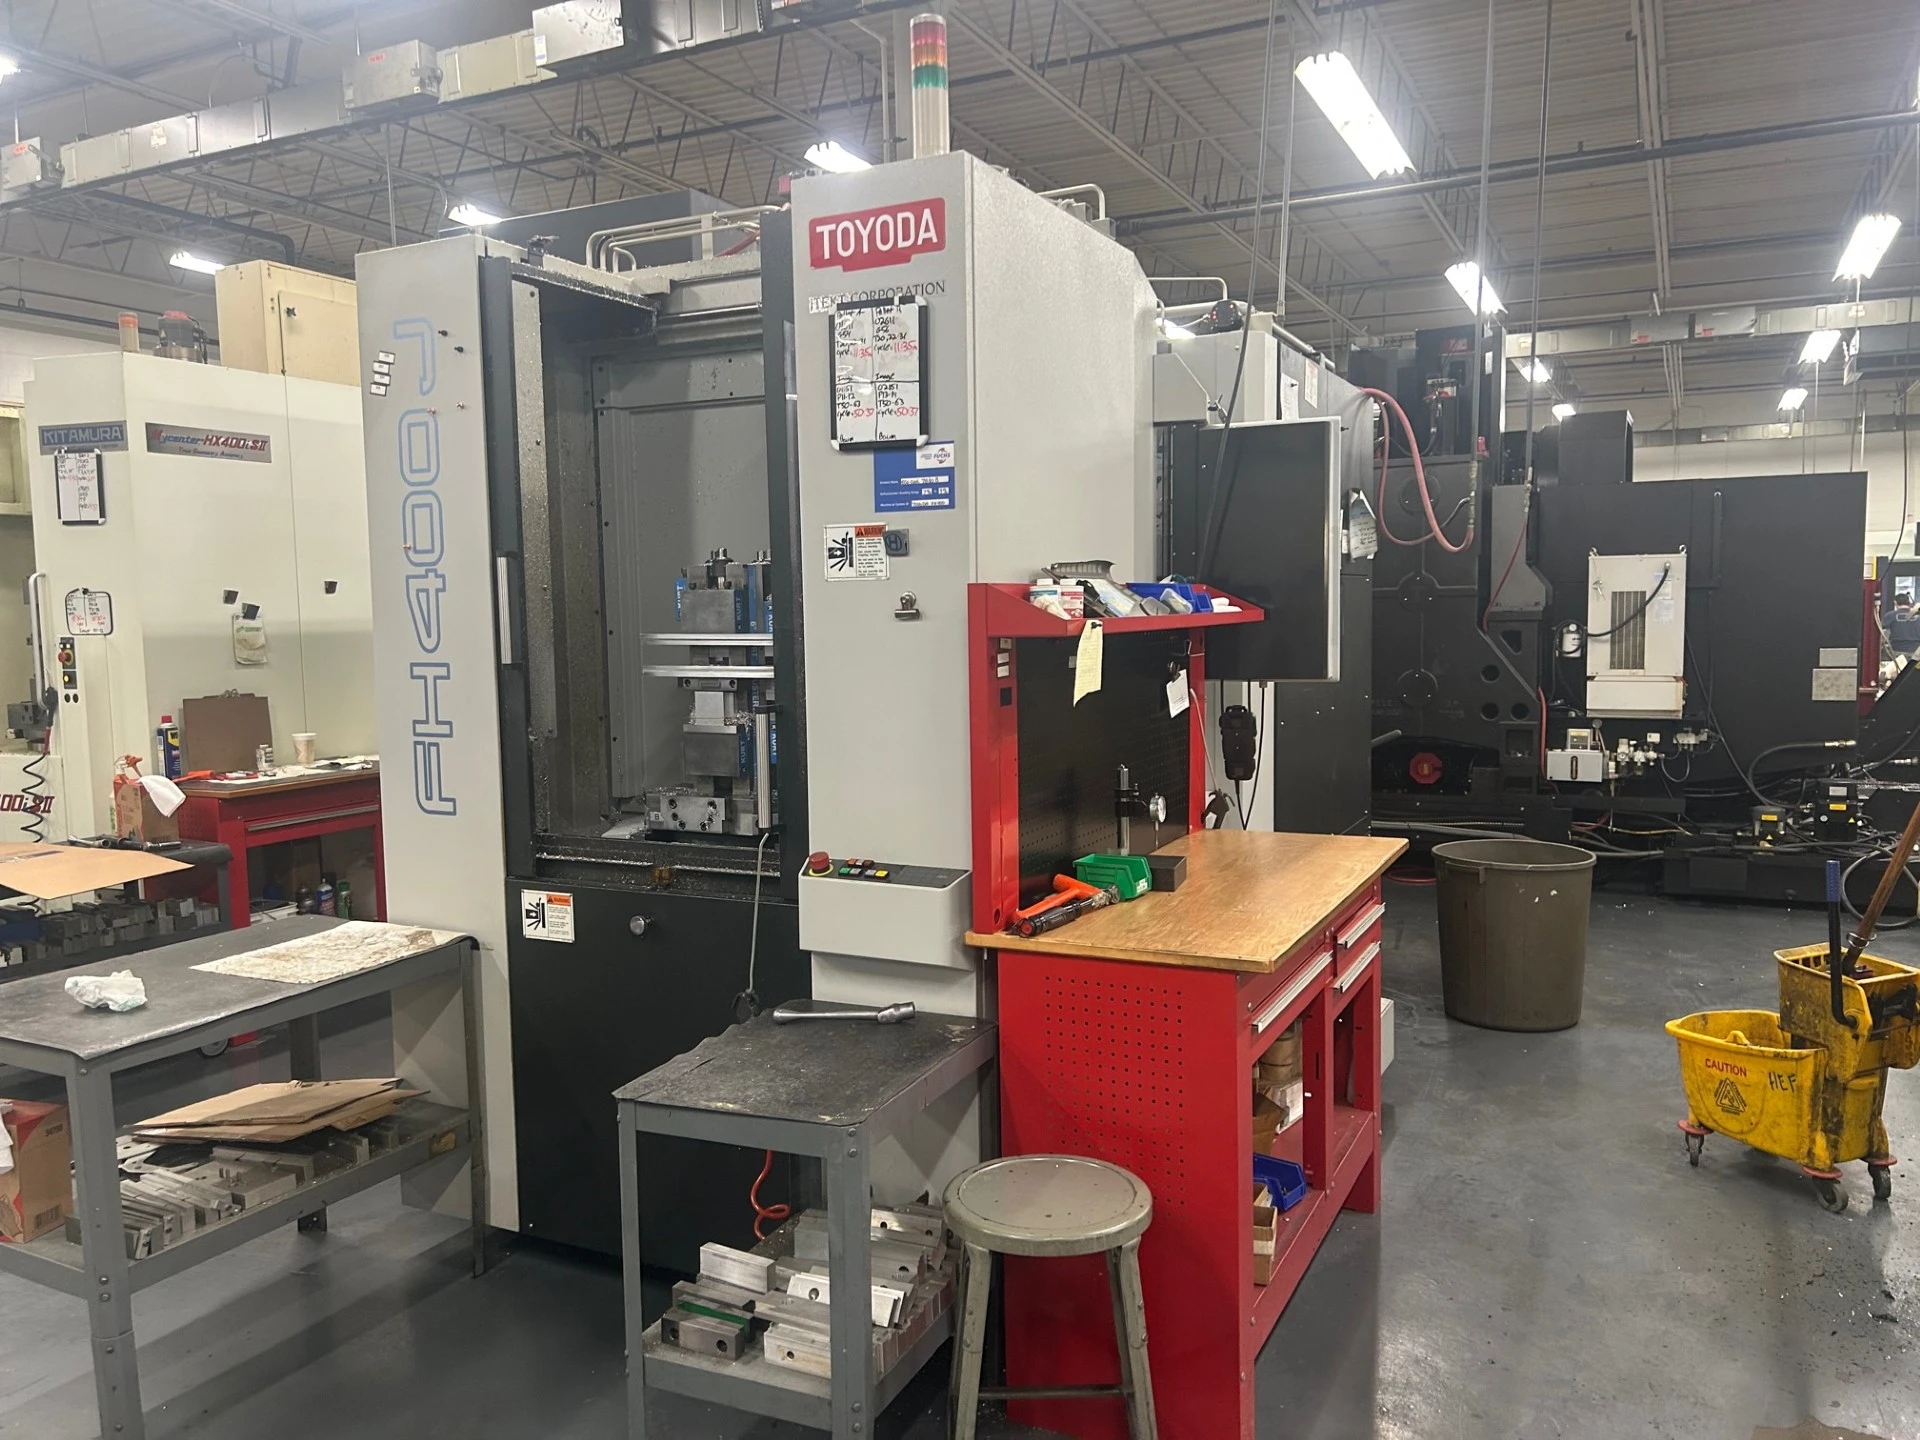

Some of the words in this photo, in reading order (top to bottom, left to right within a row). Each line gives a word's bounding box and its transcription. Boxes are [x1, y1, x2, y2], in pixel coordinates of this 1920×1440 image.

[815, 207, 938, 260] TOYODA
[43, 426, 122, 444] KITAMURA
[1705, 1058, 1747, 1077] CAUTION
